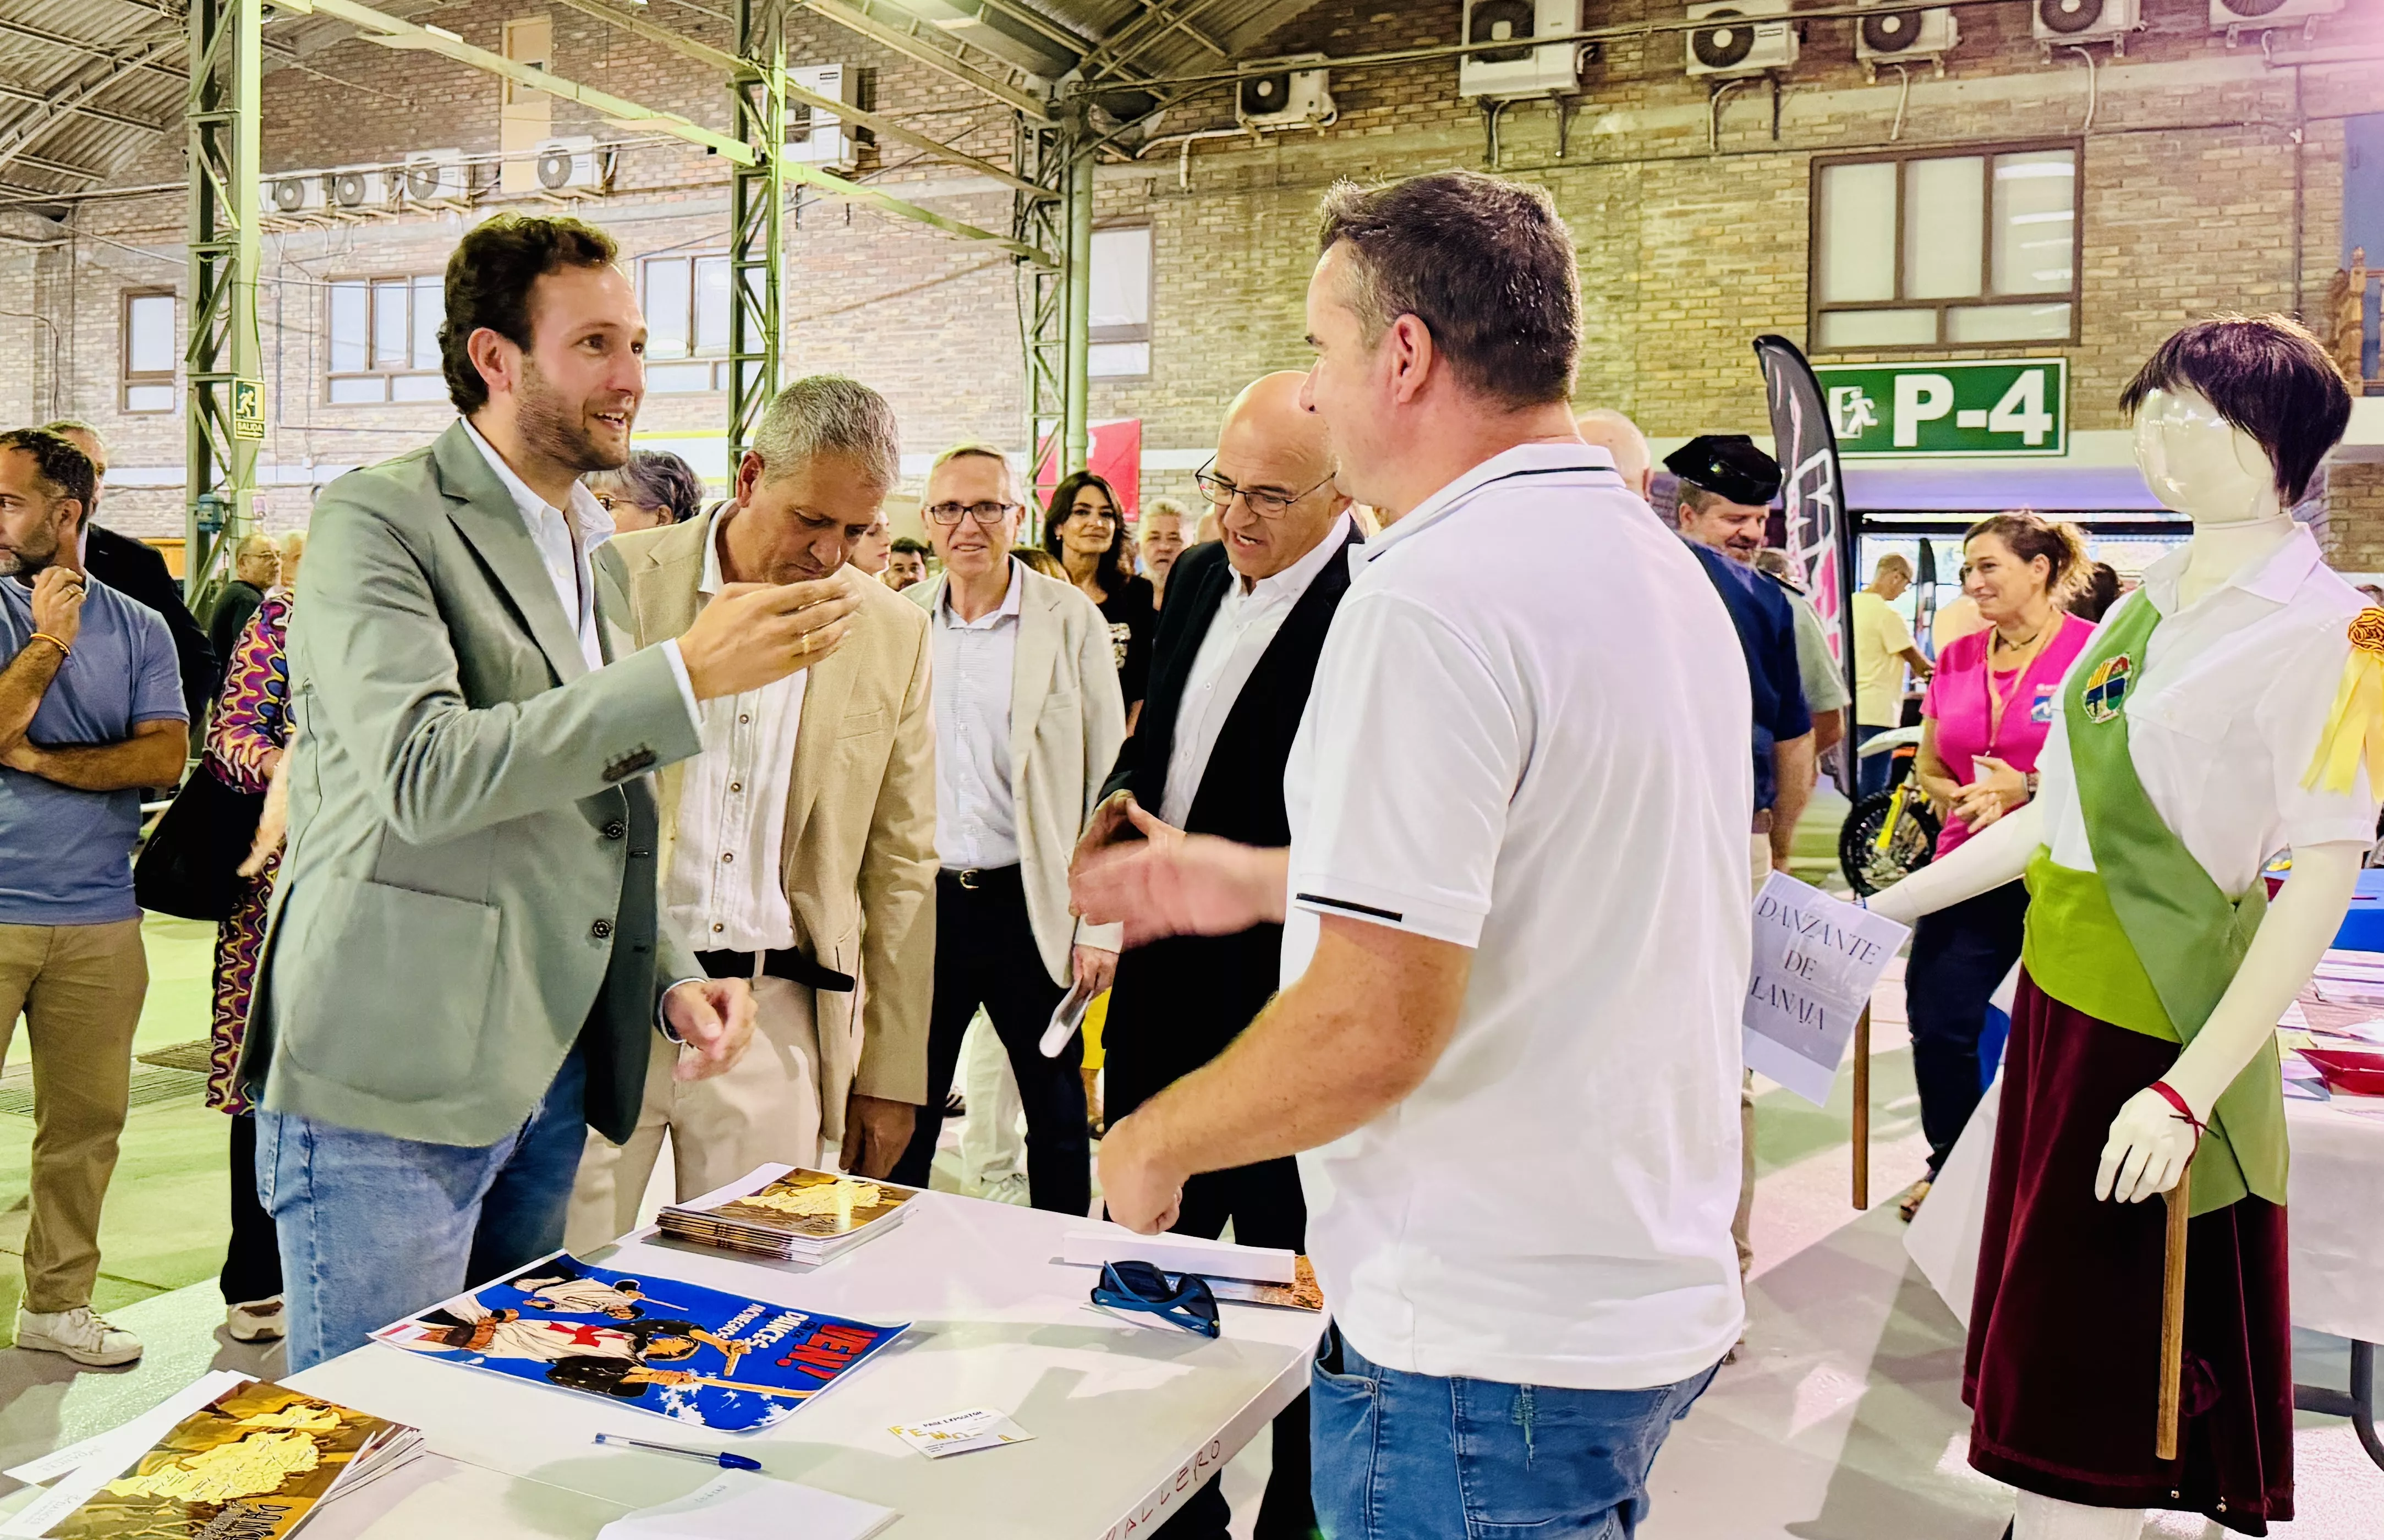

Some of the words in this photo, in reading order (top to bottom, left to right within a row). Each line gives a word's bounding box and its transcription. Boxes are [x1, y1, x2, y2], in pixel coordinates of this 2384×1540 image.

[237, 422, 263, 432] SALIDA
[1894, 369, 2053, 447] P-4
[1758, 897, 1881, 964] DANZANTE
[1785, 950, 1817, 980] DE
[1751, 976, 1824, 1030] LANAJA
[744, 1311, 809, 1349] DANCES
[776, 1324, 879, 1380] VEN!
